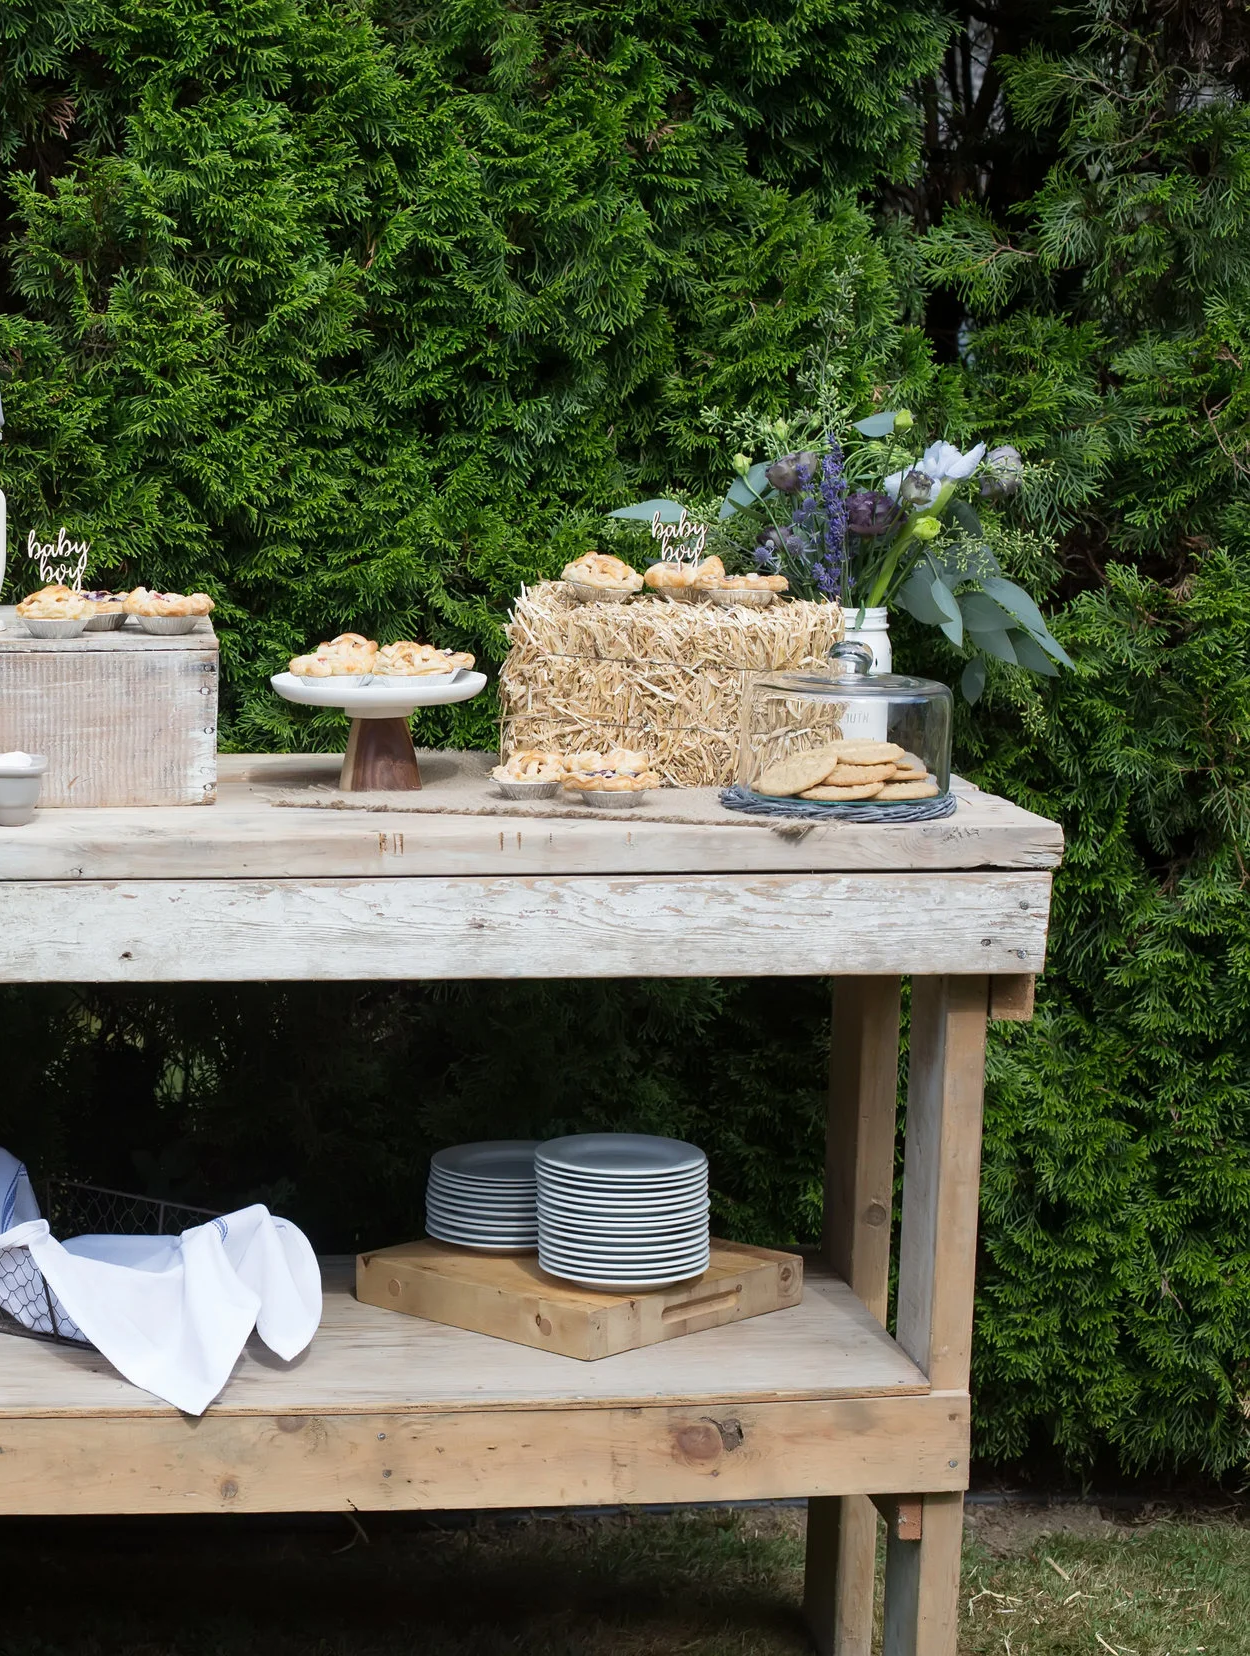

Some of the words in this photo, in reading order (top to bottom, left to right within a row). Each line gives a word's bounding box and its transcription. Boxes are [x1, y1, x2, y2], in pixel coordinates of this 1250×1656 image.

[28, 527, 91, 572] baby
[652, 509, 709, 553] baby
[662, 536, 702, 568] boy
[40, 554, 86, 593] boy
